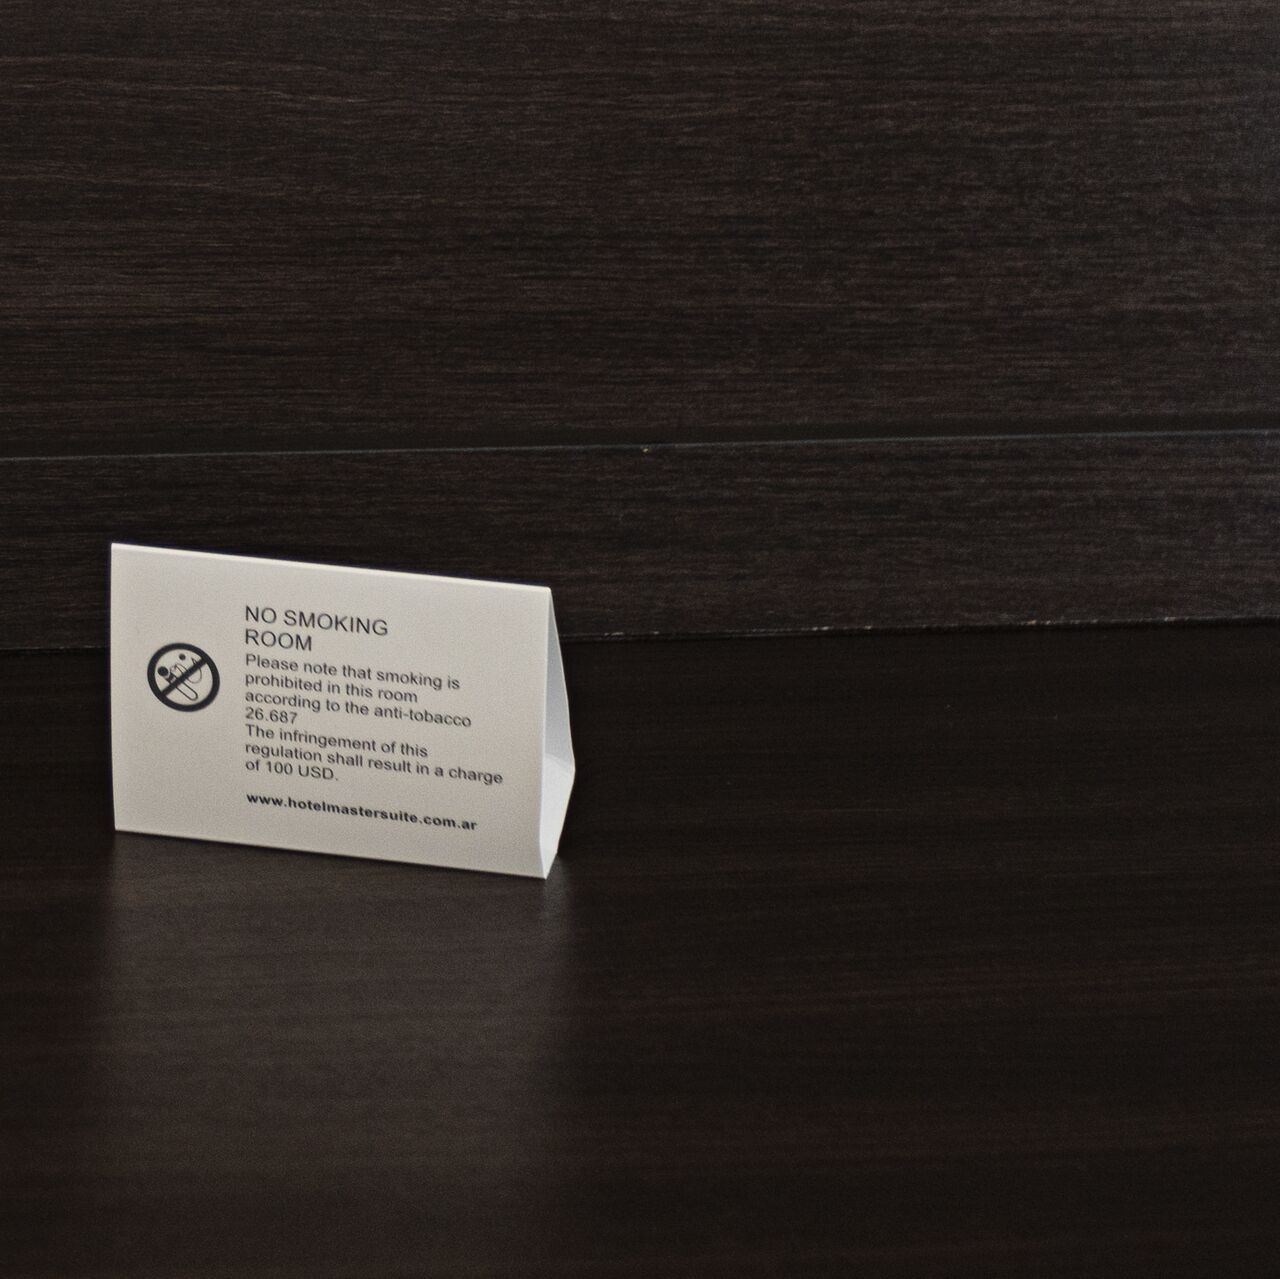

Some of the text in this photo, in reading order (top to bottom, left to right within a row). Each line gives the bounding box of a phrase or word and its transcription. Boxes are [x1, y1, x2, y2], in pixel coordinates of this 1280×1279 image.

[245, 605, 389, 636] NO SMOKING
[245, 628, 312, 651] ROOM
[245, 653, 461, 691] Please note that smoking is
[245, 673, 418, 703] prohibited in this room
[245, 691, 472, 728] according to the anti-tobacco
[245, 706, 297, 724] 26.687
[245, 723, 428, 758] The infringement of this
[245, 743, 503, 786] regulation shall result in a charge
[245, 759, 339, 781] of 100 USD.
[246, 792, 478, 831] www.hotelmastersuite.com.ar
